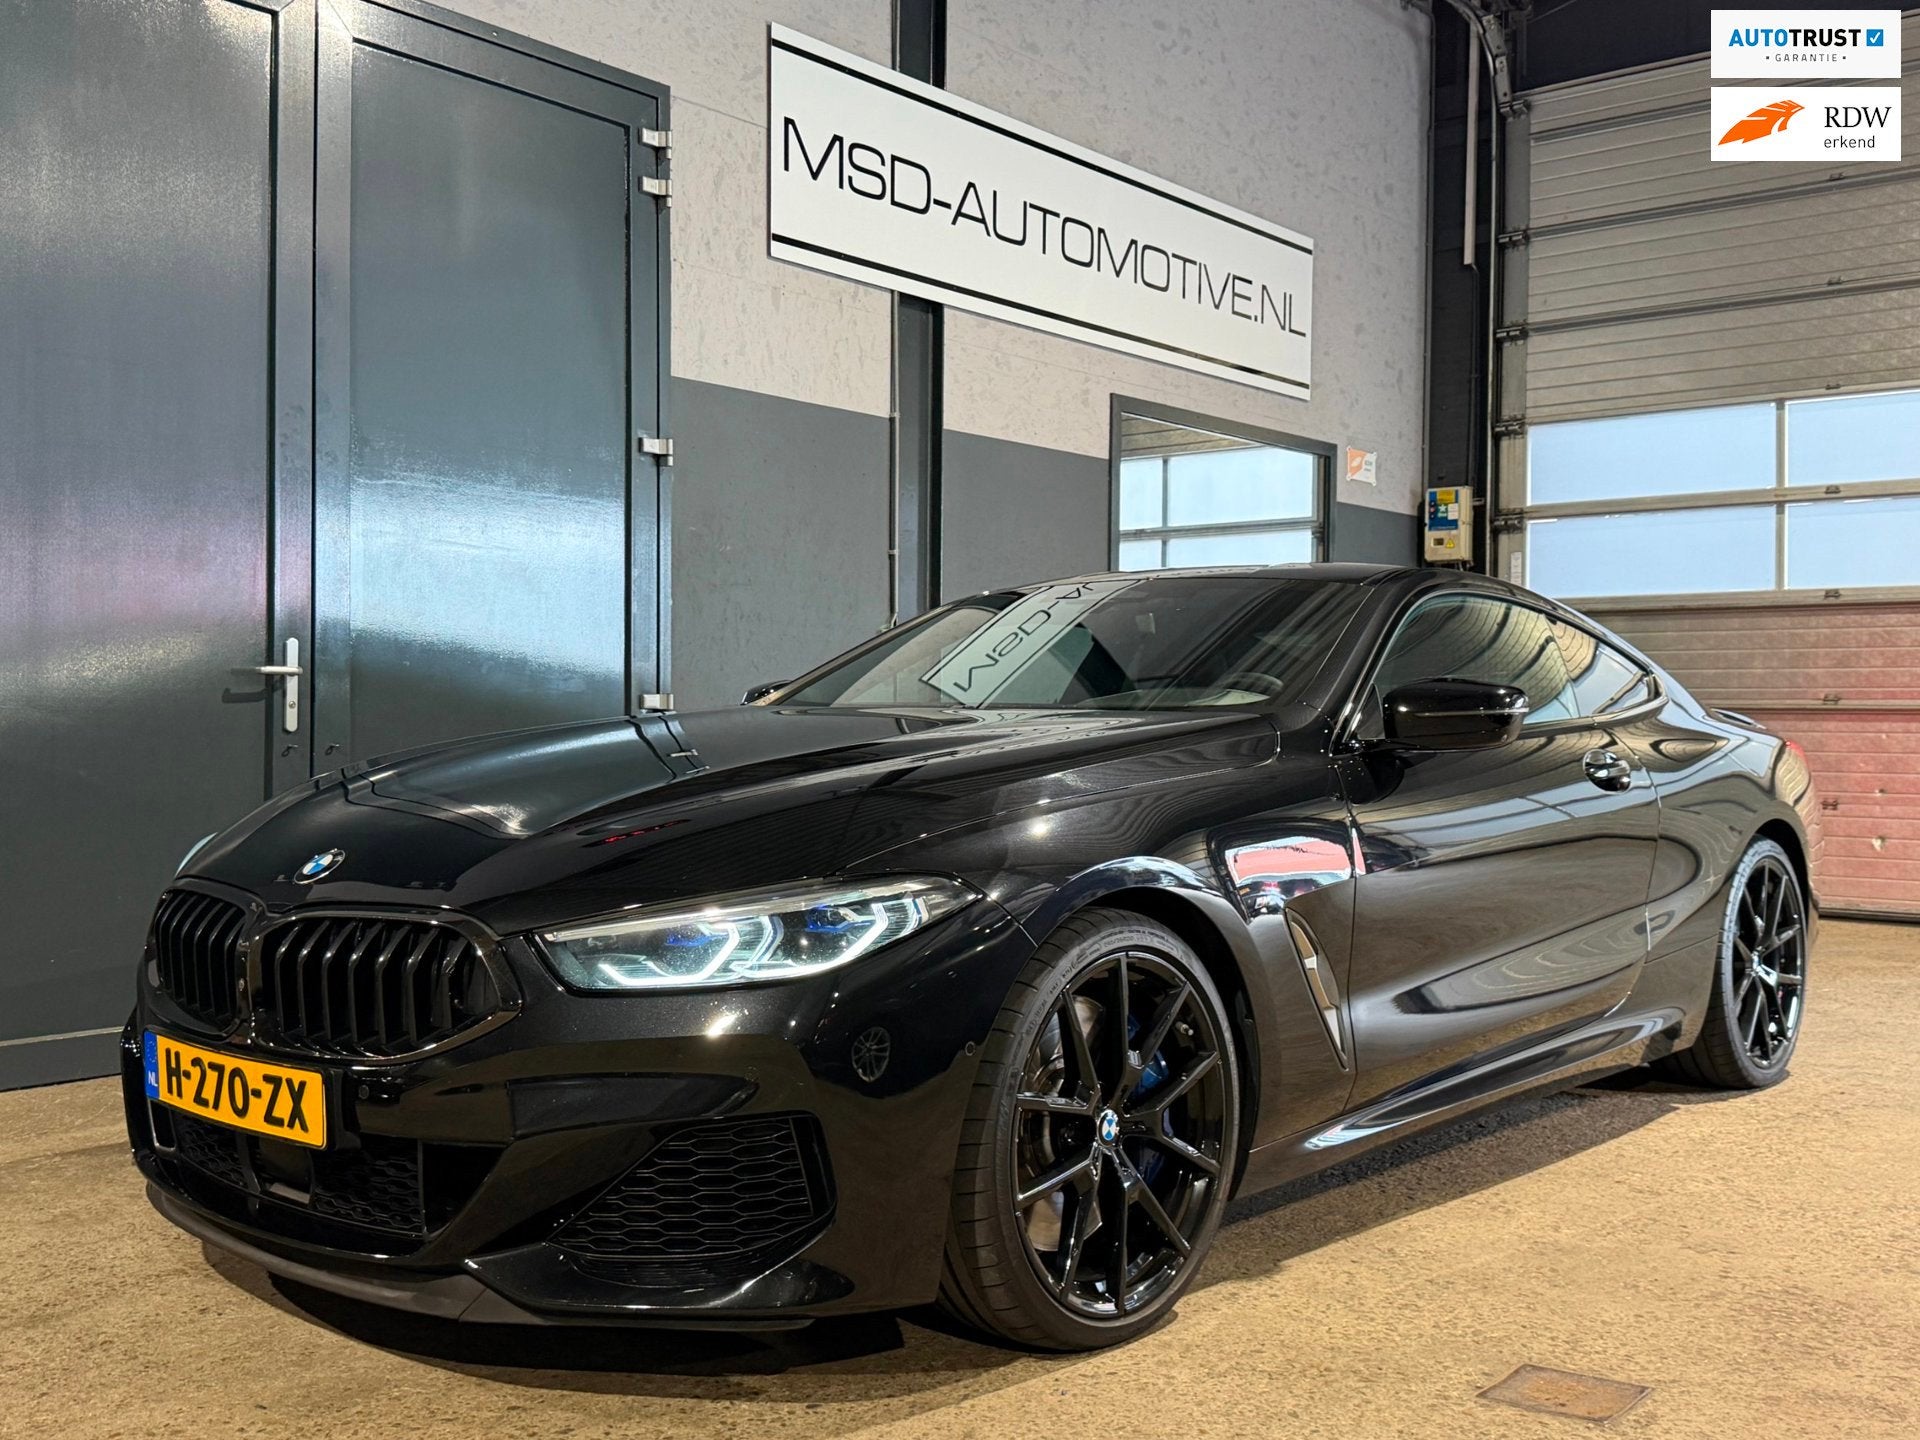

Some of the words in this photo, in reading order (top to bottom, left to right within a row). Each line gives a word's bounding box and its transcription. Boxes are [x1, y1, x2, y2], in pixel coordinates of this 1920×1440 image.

[783, 116, 1306, 337] MSD-AUTOMOTIVE.NL
[148, 1070, 158, 1087] NL
[165, 1047, 309, 1134] H-270-ZX
